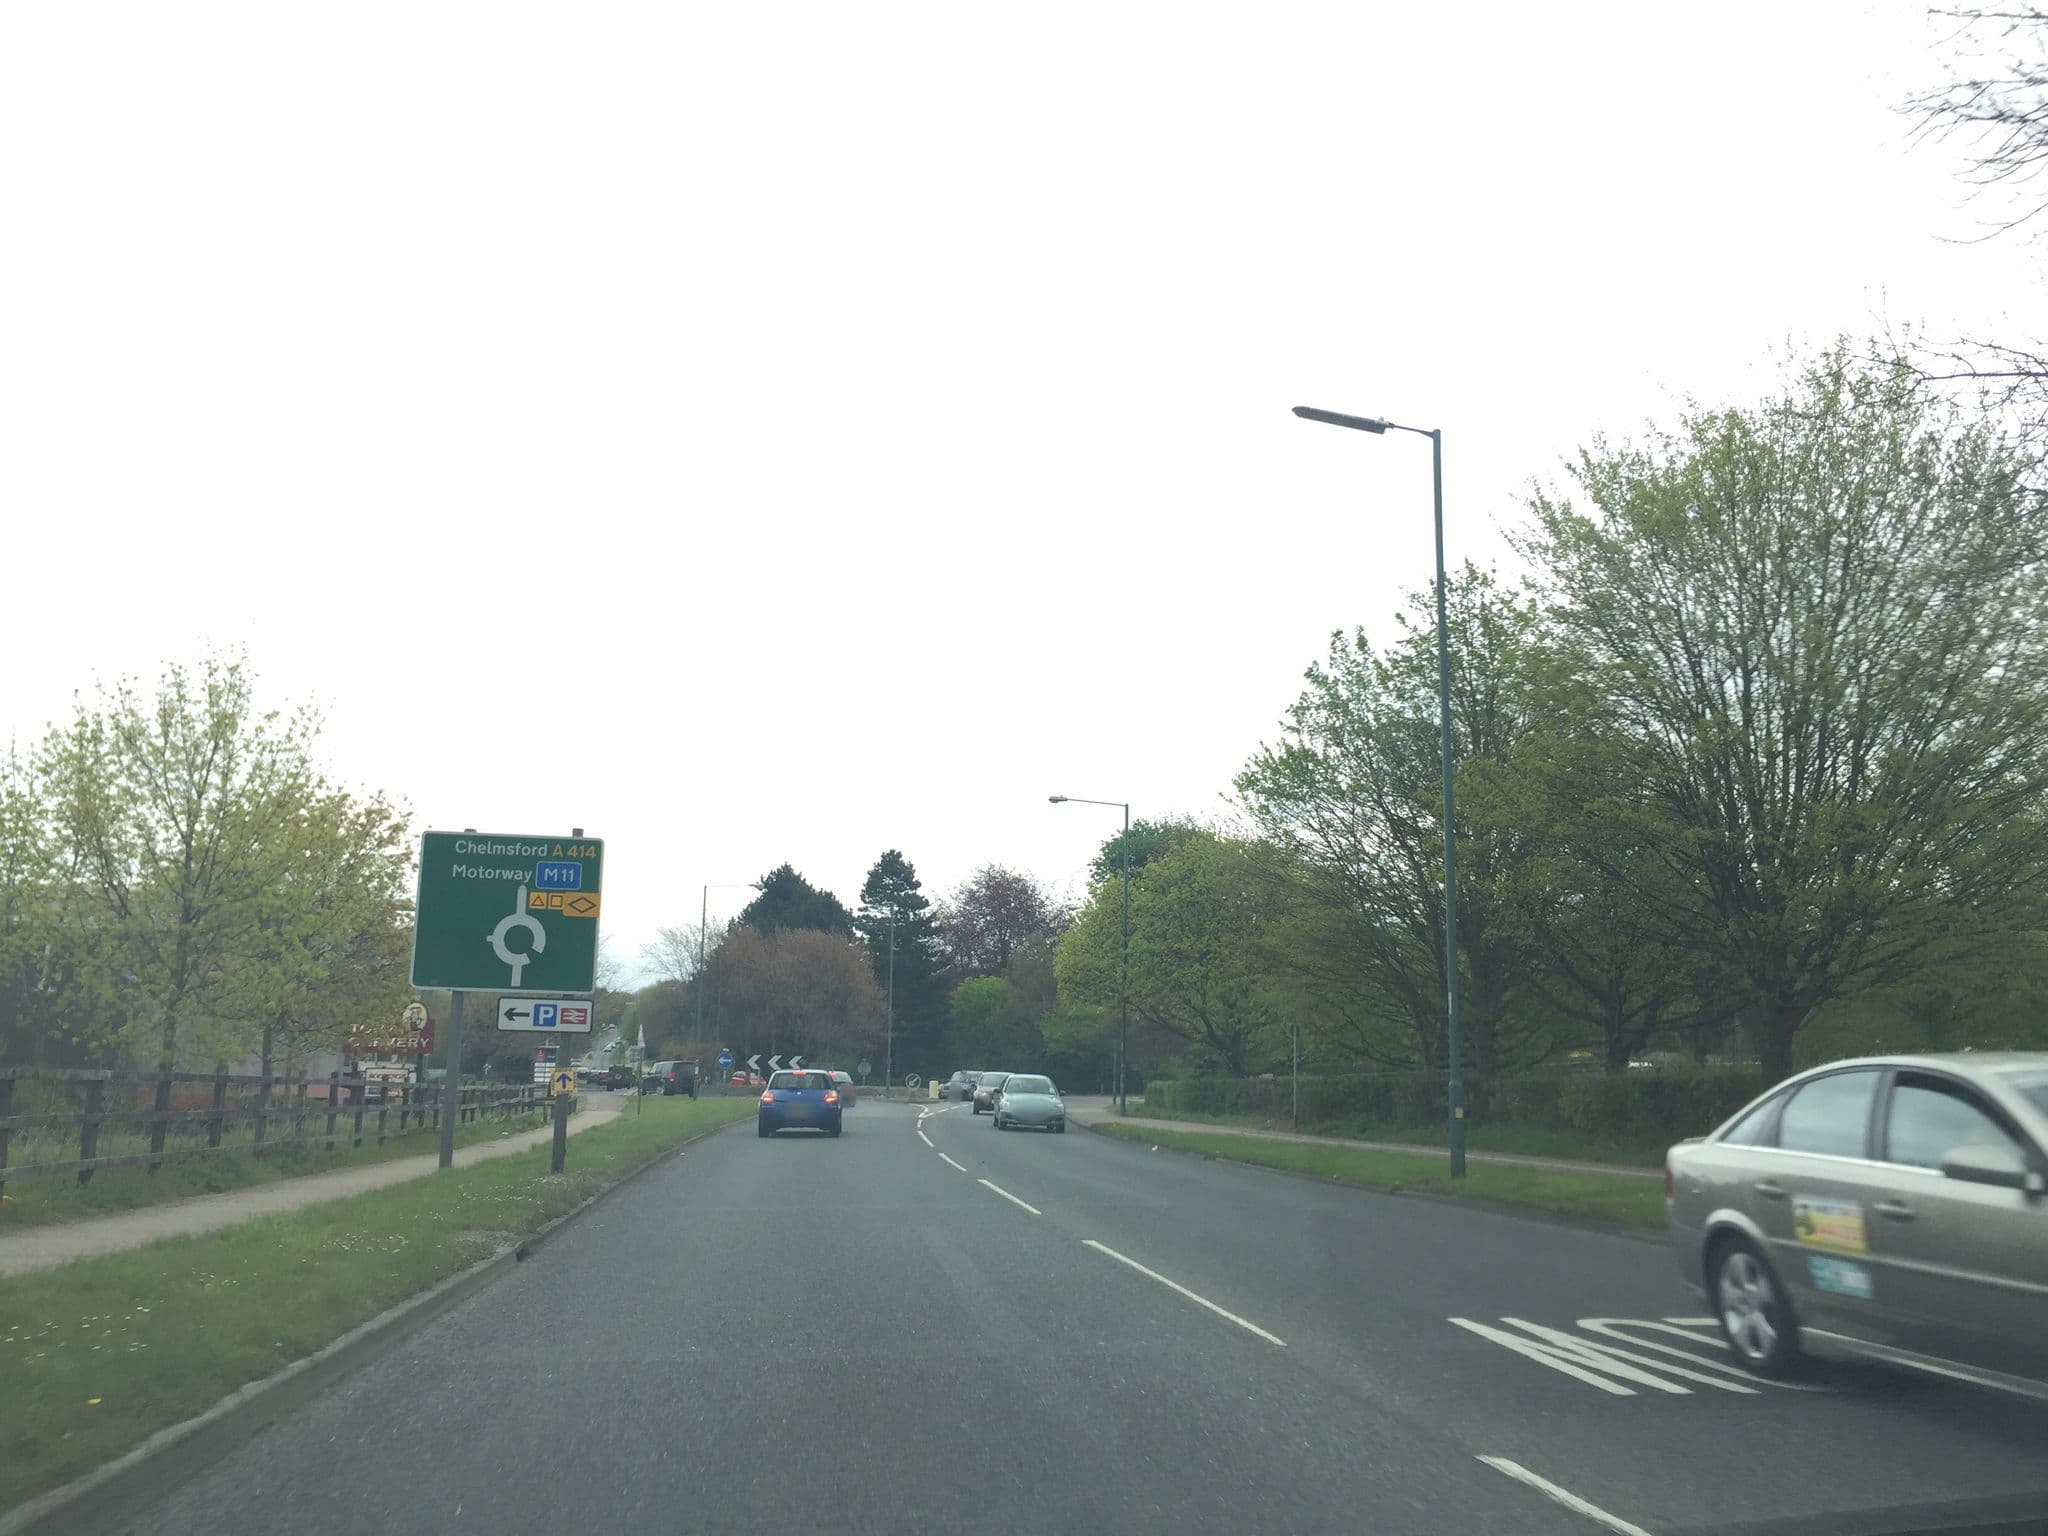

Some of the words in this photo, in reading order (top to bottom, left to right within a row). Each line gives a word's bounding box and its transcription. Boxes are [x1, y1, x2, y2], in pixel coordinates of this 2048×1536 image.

[455, 839, 548, 857] Chelmsford
[552, 843, 563, 857] A
[567, 844, 597, 859] 414
[452, 864, 533, 883] Motorway
[538, 1006, 554, 1025] P
